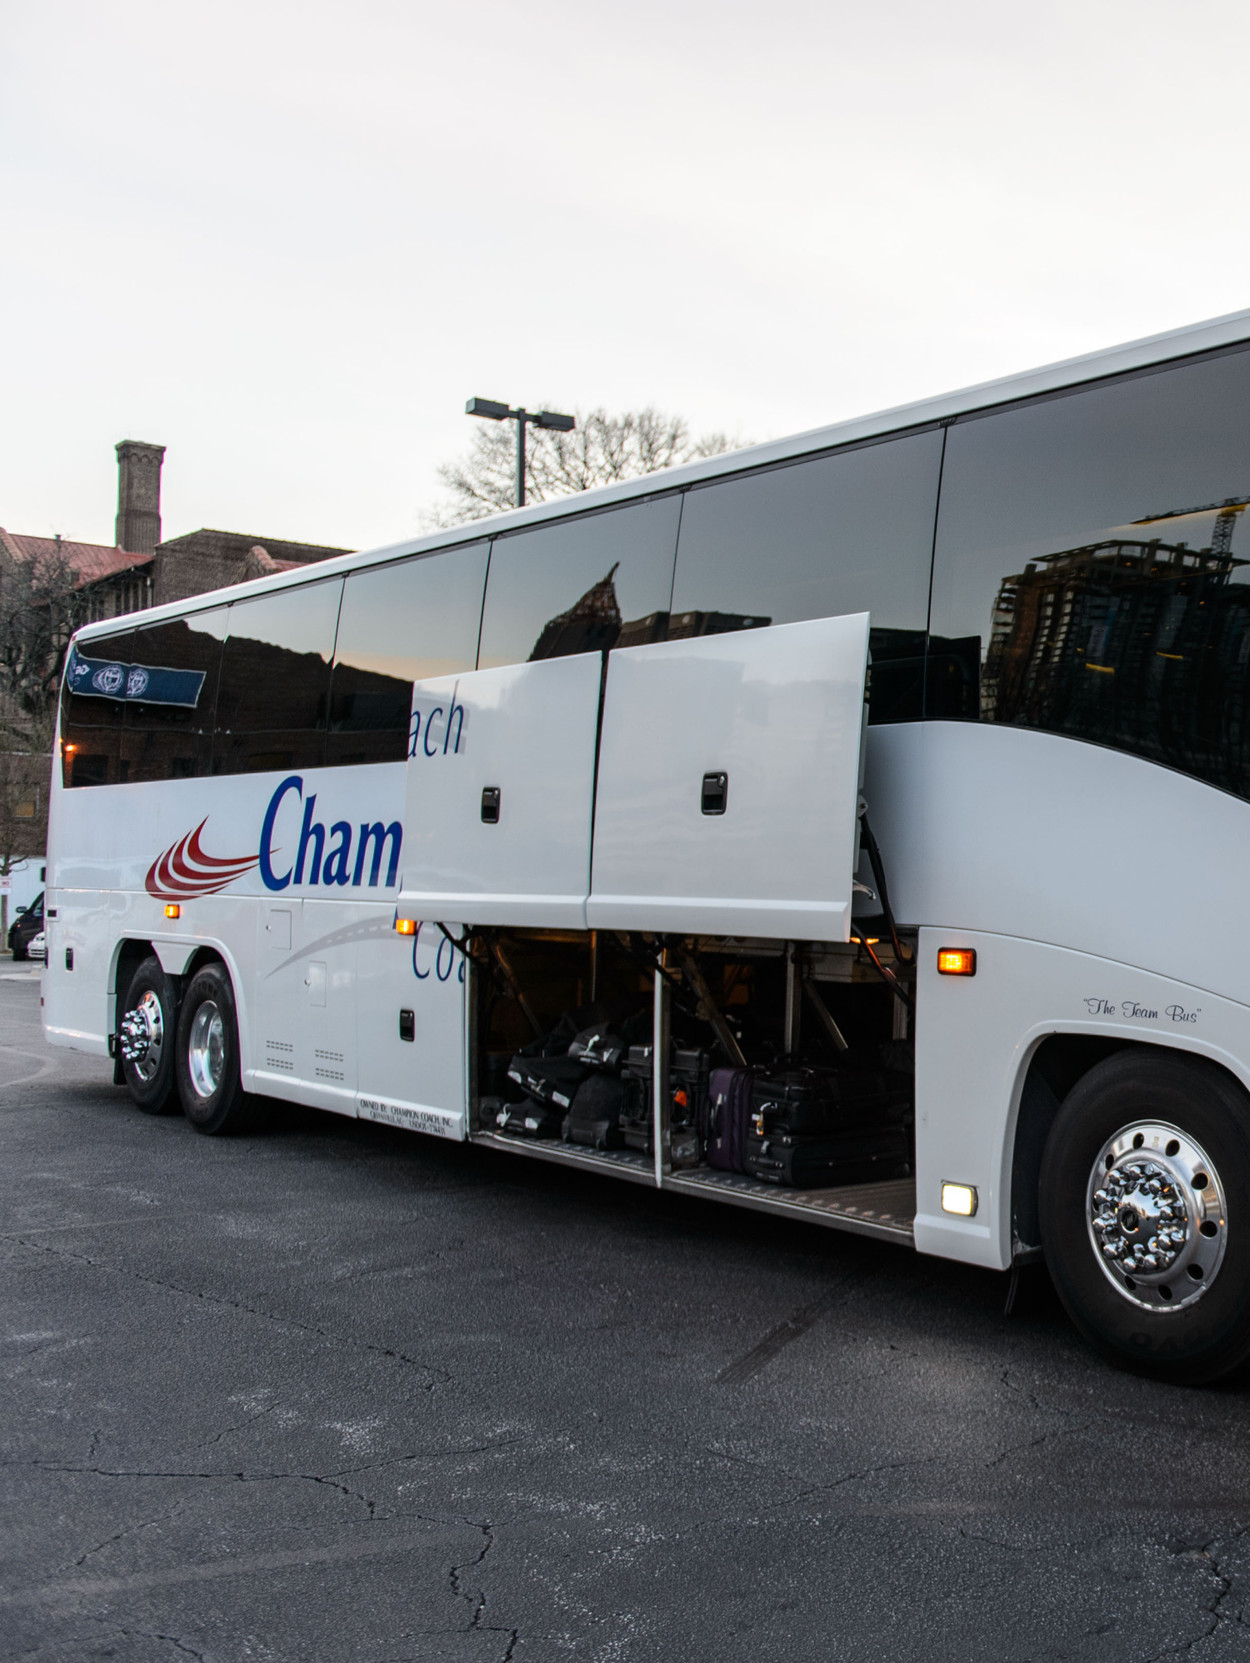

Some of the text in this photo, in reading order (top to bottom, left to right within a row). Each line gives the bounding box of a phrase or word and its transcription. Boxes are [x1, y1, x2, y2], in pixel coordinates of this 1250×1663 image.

[259, 775, 403, 893] Cham
[1121, 1001, 1159, 1019] Team
[360, 1099, 379, 1110] OWNED
[391, 1105, 419, 1120] CHAMPION
